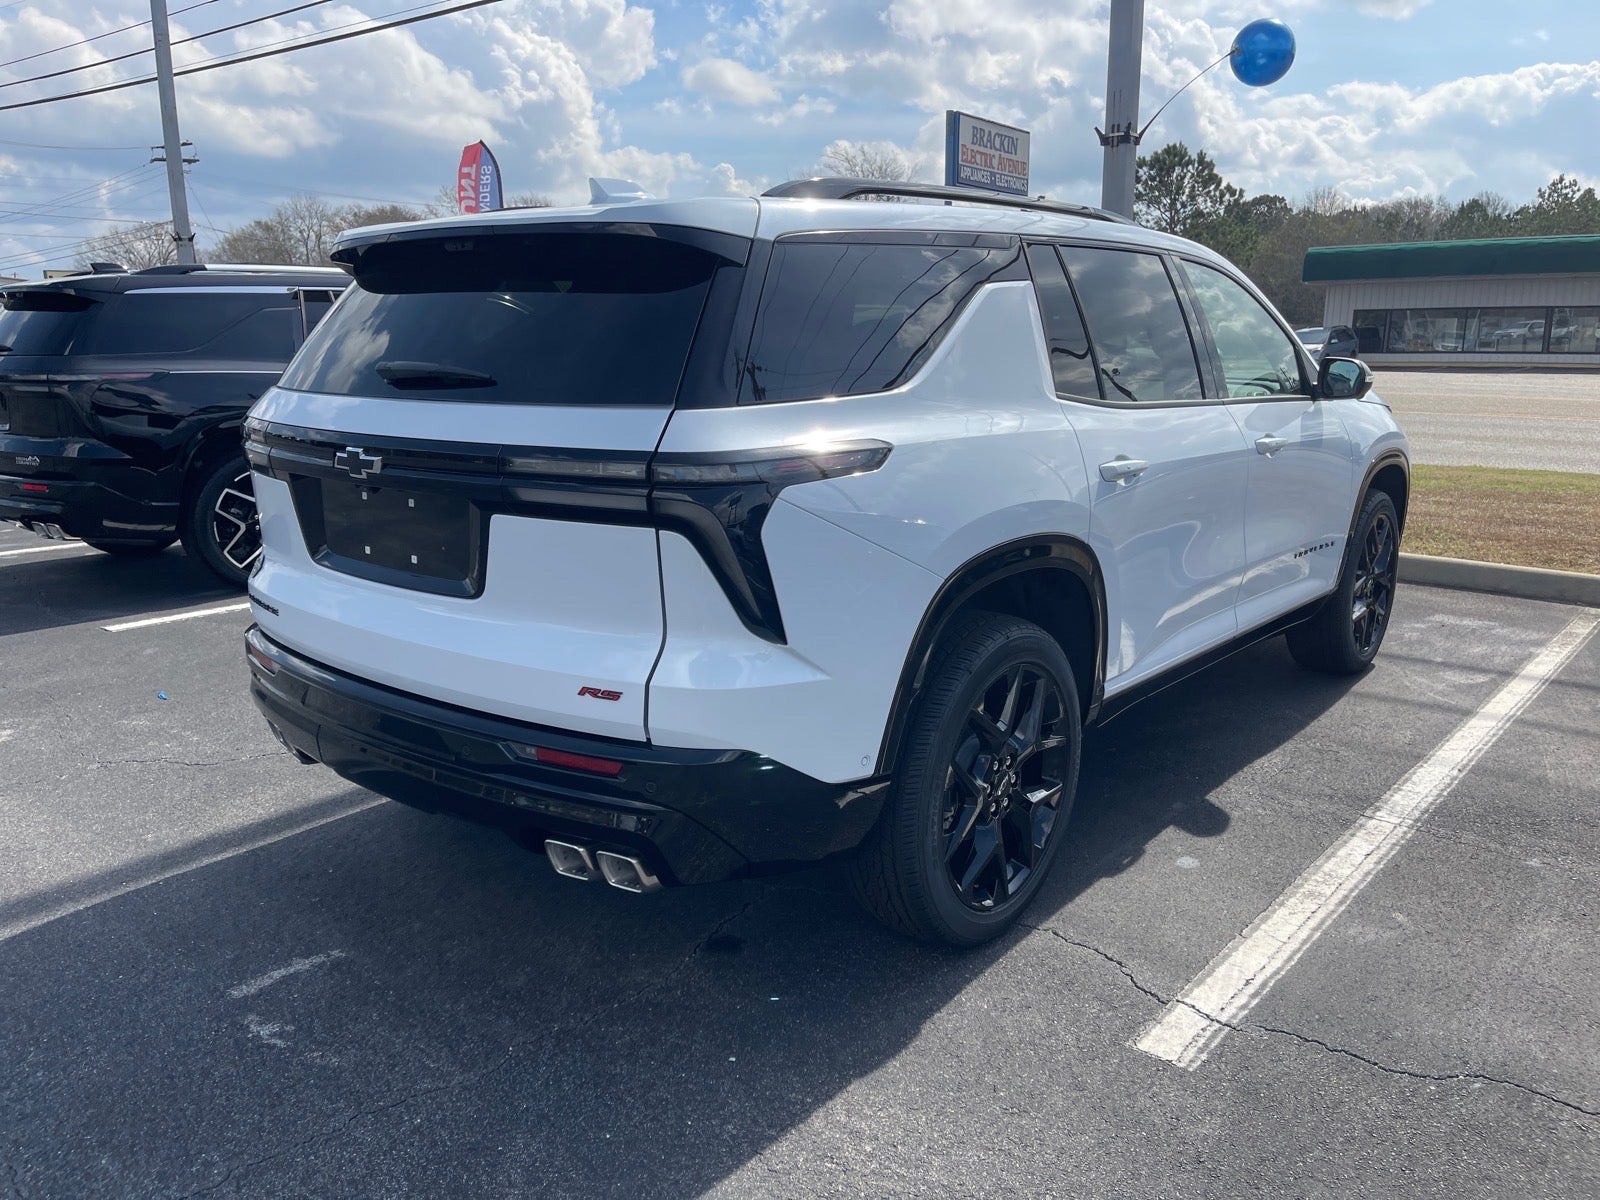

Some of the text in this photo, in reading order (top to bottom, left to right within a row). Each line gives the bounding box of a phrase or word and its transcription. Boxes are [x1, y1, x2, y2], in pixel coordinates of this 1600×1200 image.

[971, 126, 1018, 155] BRACKIN
[960, 166, 1027, 191] APPLIANCES ELECTRONICS
[577, 686, 623, 701] RS
